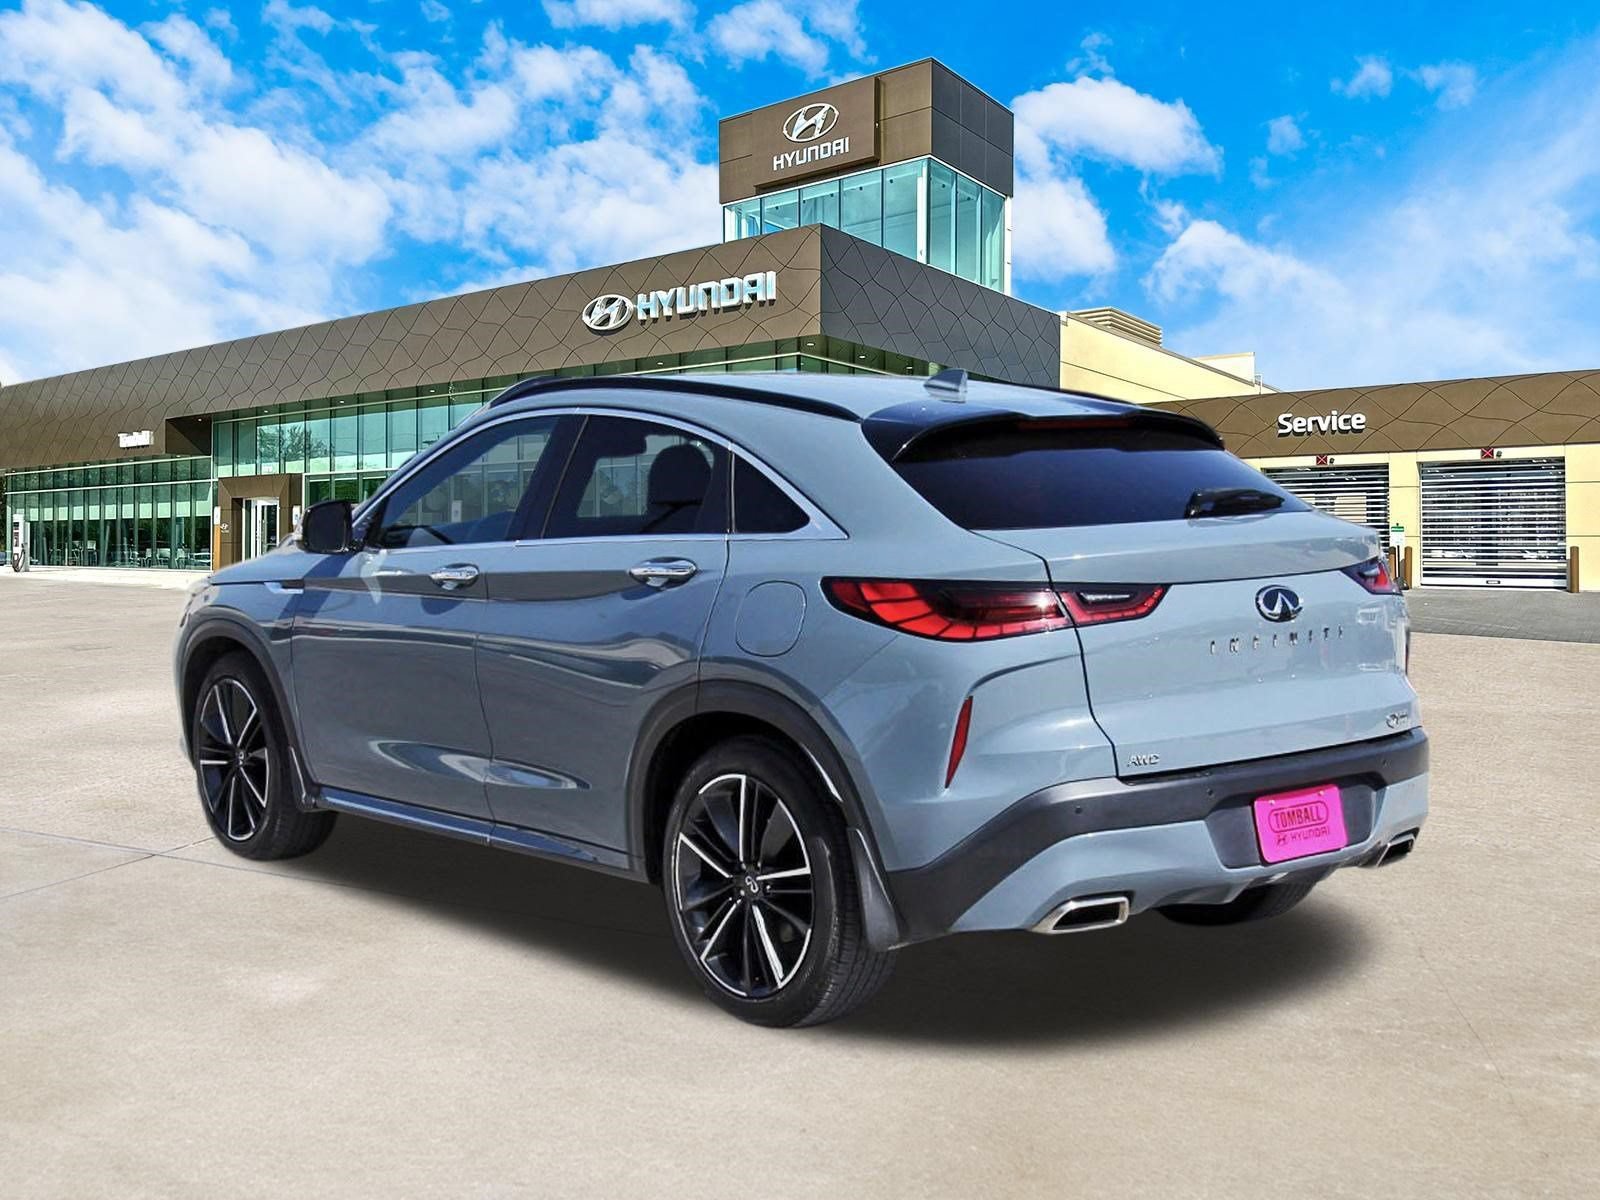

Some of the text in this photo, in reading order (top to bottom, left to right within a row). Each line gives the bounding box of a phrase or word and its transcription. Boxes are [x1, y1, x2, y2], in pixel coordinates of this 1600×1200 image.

[773, 136, 850, 171] HYUNDAI
[637, 271, 777, 321] HYUNDAI
[1277, 409, 1367, 435] Service
[1210, 624, 1343, 655] INFINITI
[1274, 806, 1323, 829] TOMBALL
[1290, 826, 1329, 841] HYUNDAI
